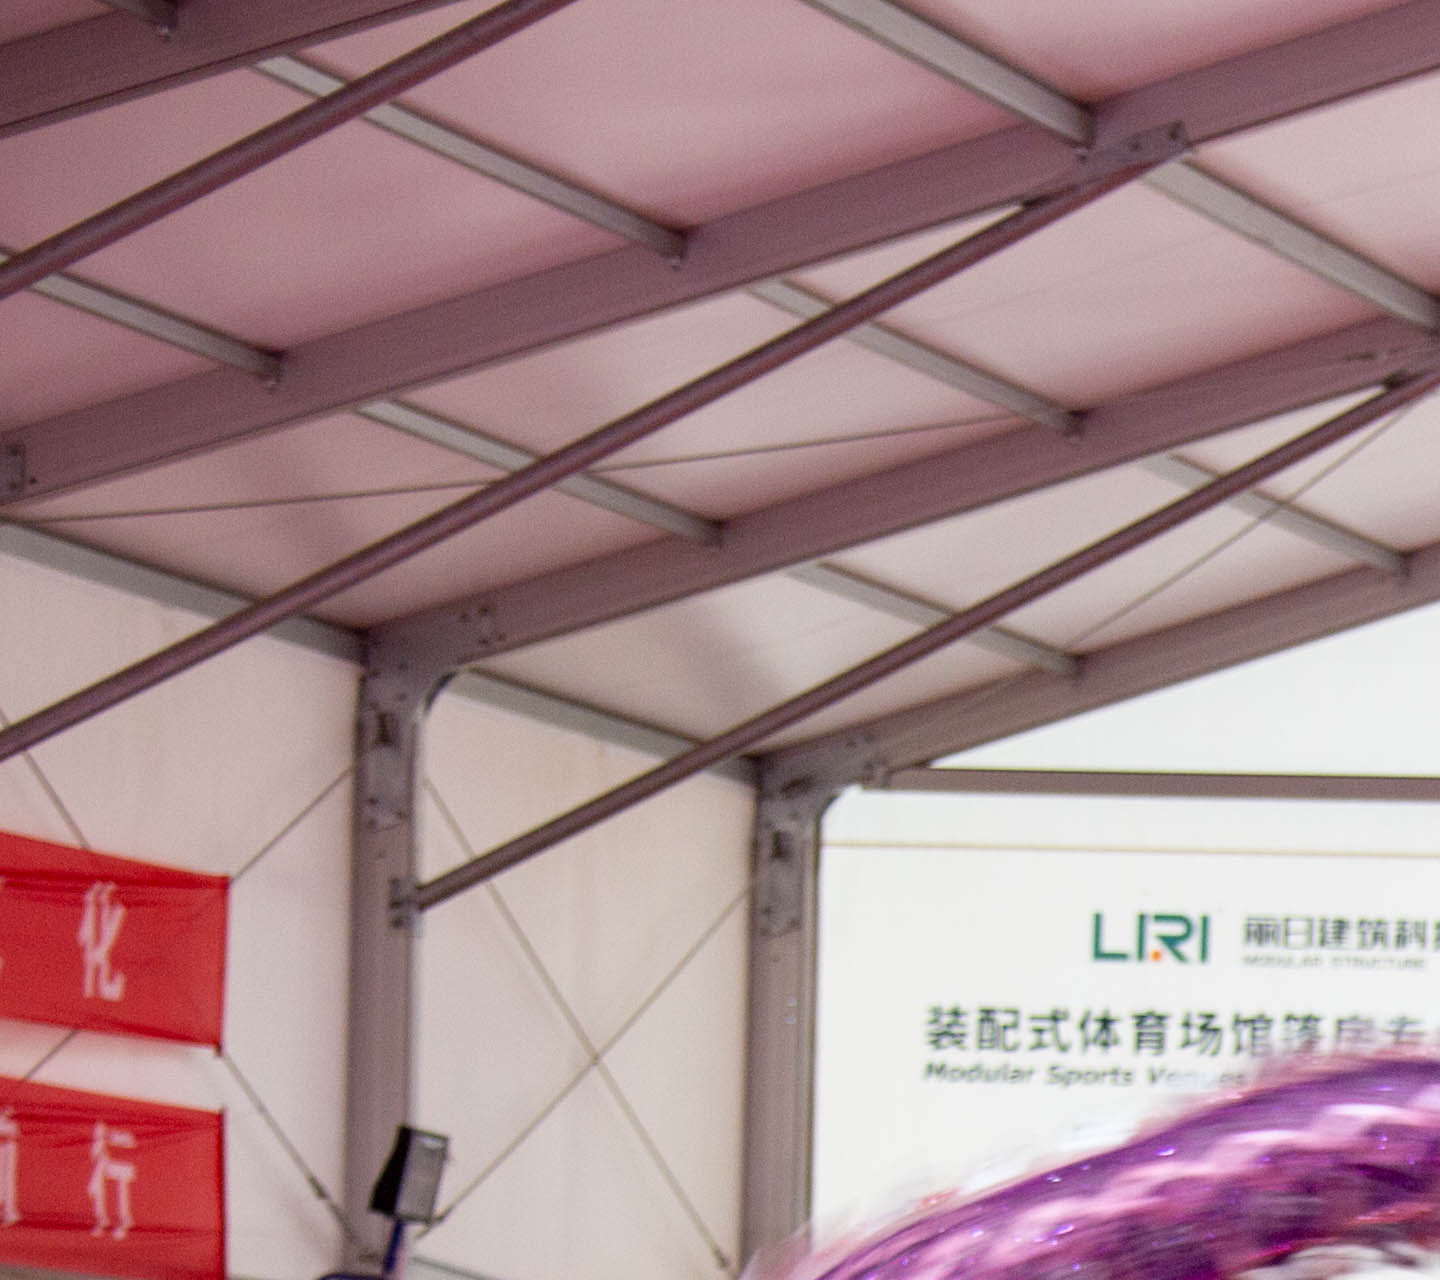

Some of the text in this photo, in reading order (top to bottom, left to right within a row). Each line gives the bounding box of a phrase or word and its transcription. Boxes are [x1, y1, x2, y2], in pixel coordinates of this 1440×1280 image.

[1093, 912, 1209, 963] LIRI
[925, 1061, 1035, 1084] Modular
[1048, 1065, 1134, 1088] Sports
